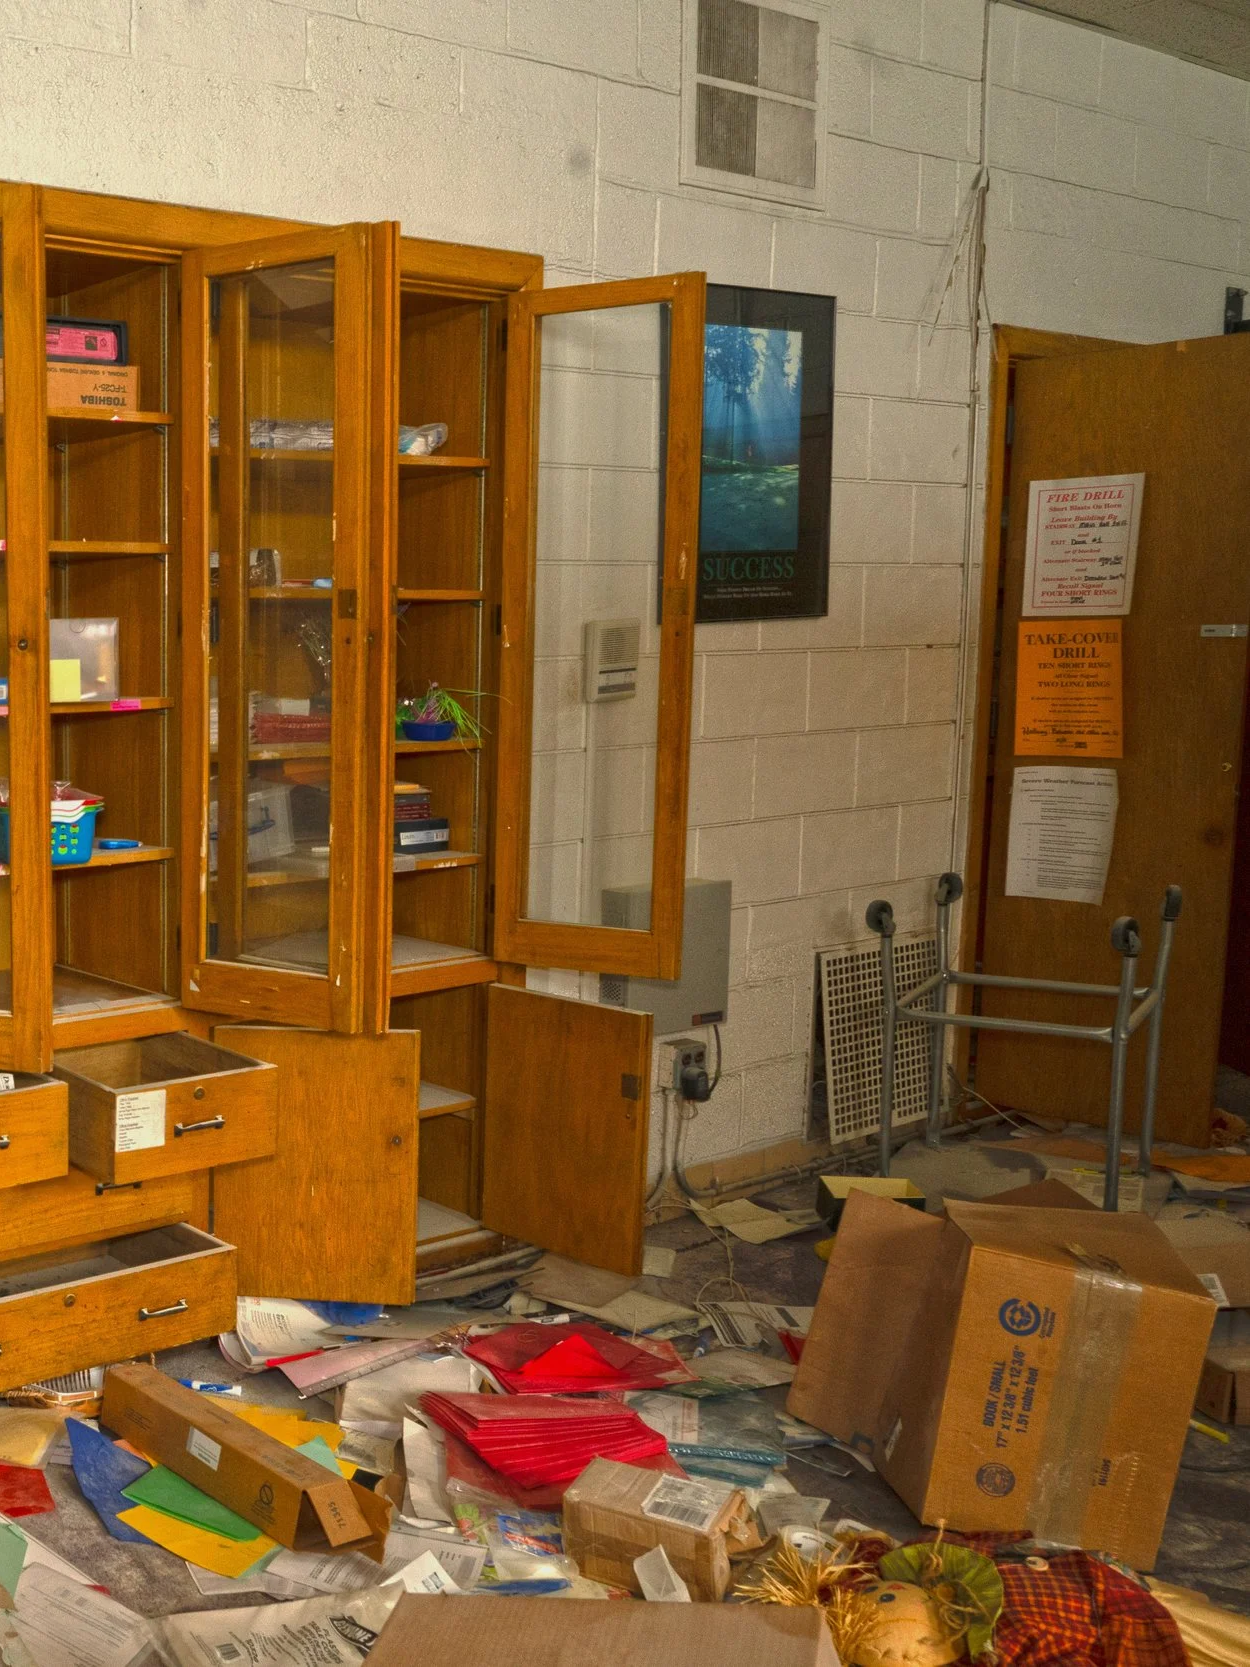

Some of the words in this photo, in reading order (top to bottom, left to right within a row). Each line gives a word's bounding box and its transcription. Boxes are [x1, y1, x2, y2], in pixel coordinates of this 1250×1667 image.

[80, 394, 126, 406] TOSHIBA
[1046, 492, 1079, 503] FIRE
[1083, 489, 1125, 501] DRILL
[703, 556, 795, 581] SUCCESS
[1053, 647, 1100, 659] DRILL
[989, 1361, 1007, 1392] SMALL
[1025, 1367, 1039, 1387] feet
[1002, 1409, 1013, 1422] 12
[1009, 1366, 1021, 1379] 12
[1021, 1387, 1035, 1412] cubic
[983, 1399, 999, 1427] BOOK
[1015, 1413, 1029, 1434] 1.51
